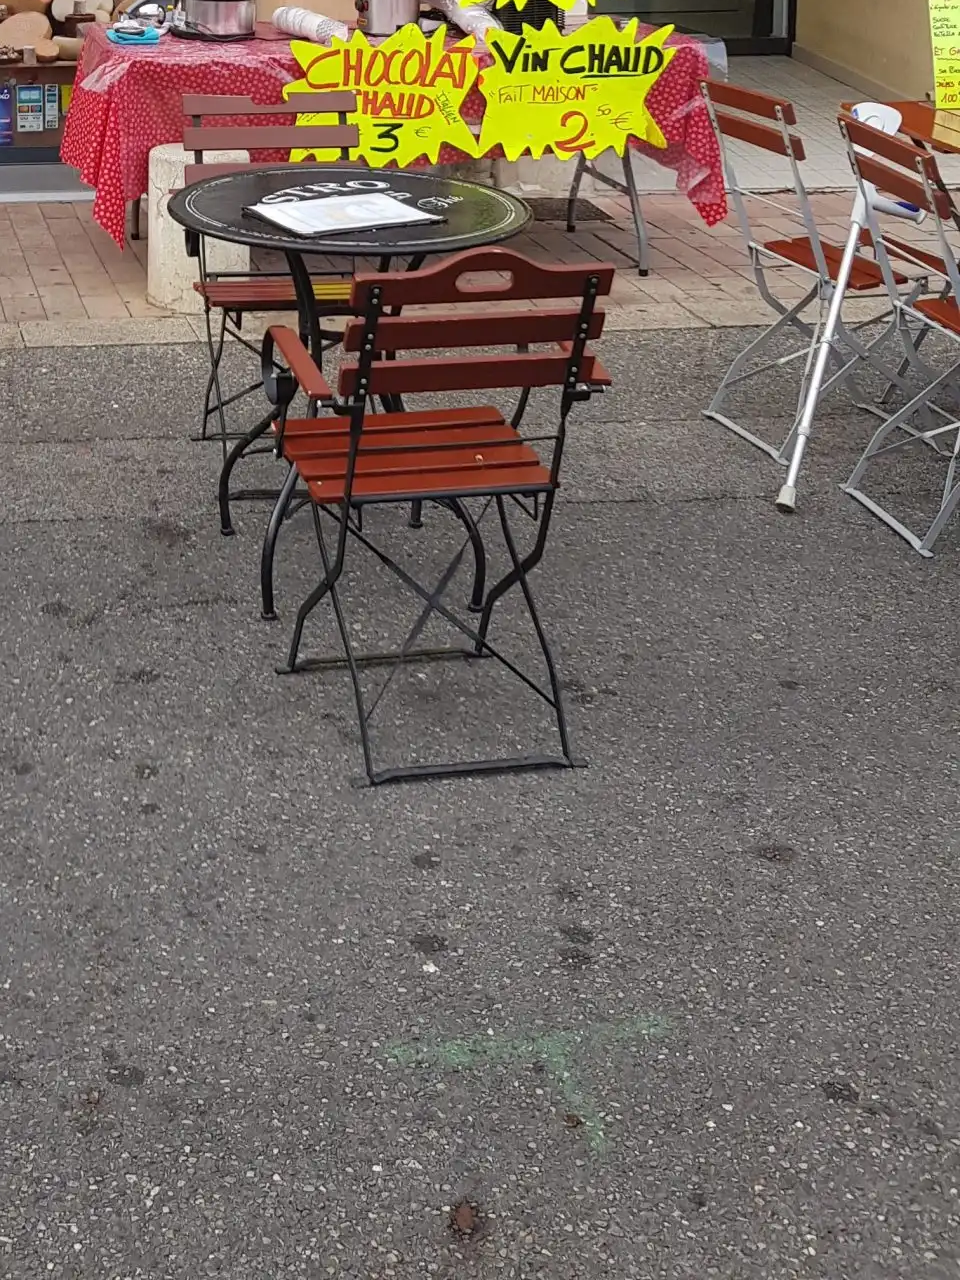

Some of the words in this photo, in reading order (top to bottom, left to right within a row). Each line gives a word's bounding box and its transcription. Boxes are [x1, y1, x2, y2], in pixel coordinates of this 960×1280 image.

[306, 42, 473, 89] CHOCOLAT
[491, 37, 552, 74] VIN
[560, 43, 664, 79] CHAUD
[356, 89, 435, 119] HAUD
[370, 123, 403, 152] 3
[414, 126, 431, 138] €
[555, 111, 595, 152] 2
[610, 111, 633, 131] €
